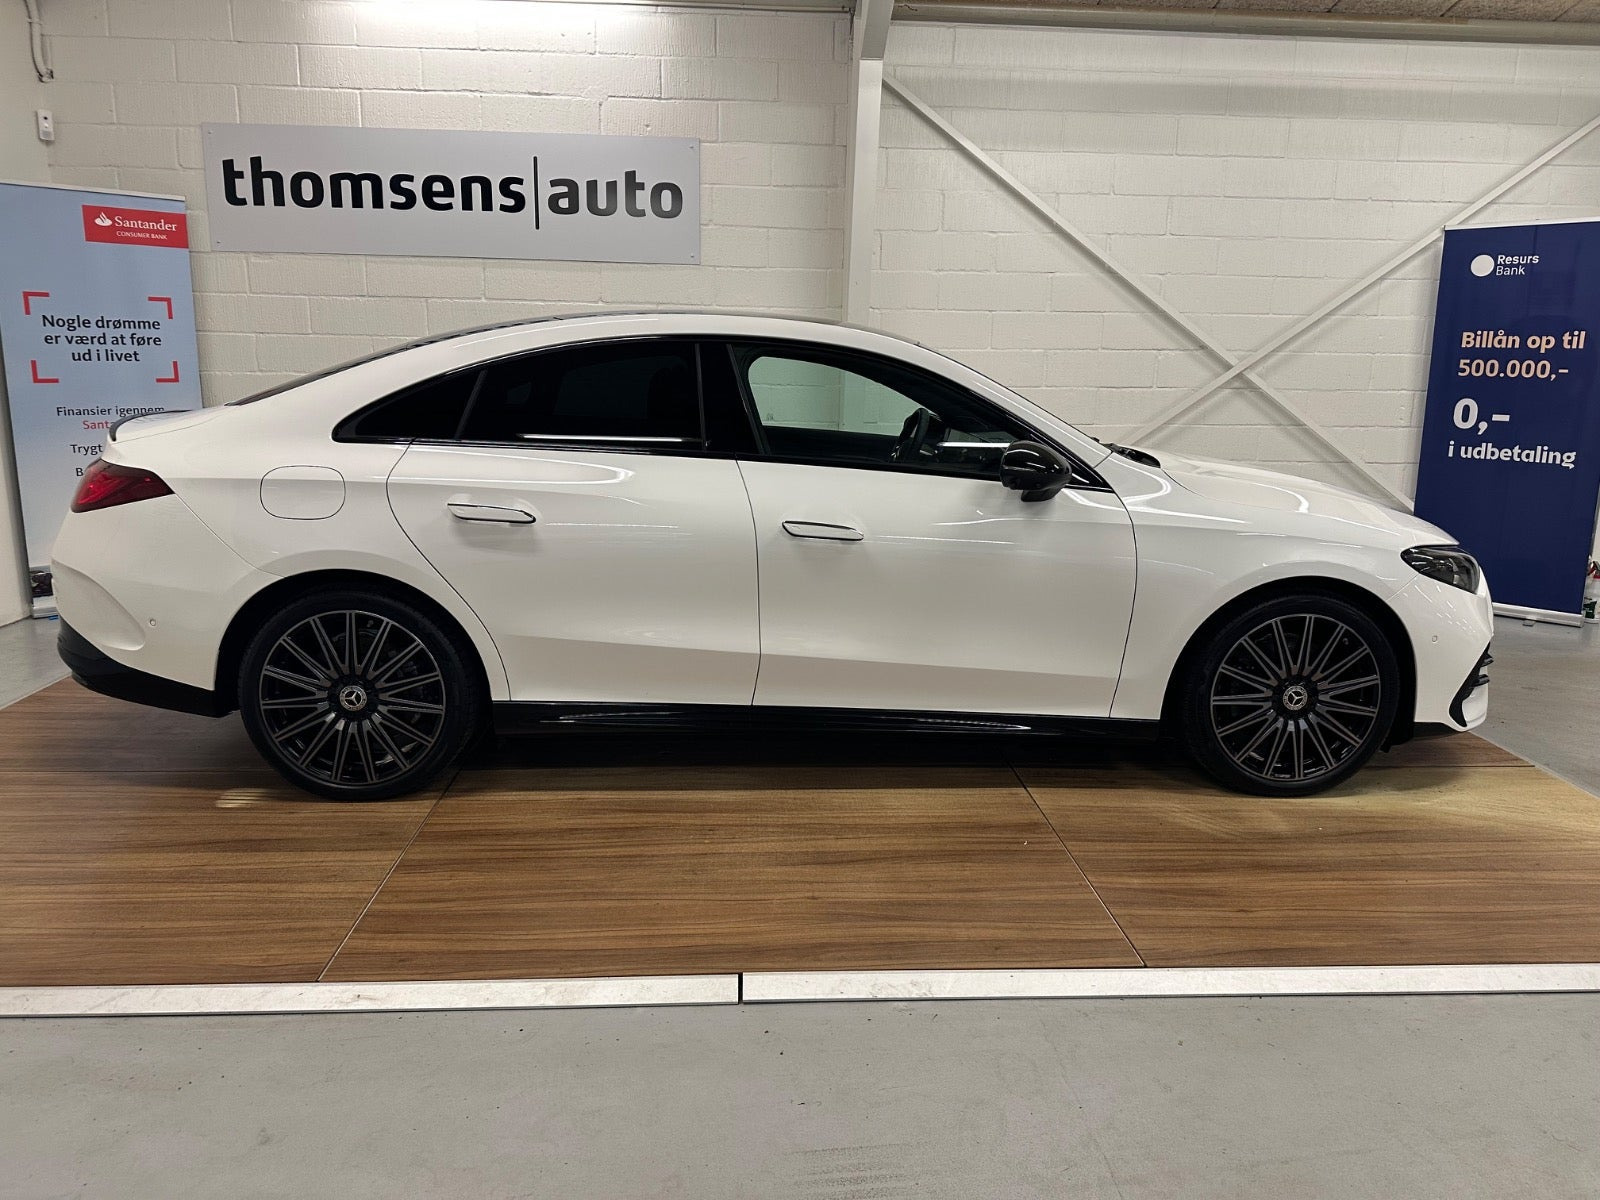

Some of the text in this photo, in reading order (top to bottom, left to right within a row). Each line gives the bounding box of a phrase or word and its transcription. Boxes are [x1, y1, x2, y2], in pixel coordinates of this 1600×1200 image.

[222, 156, 683, 219] thomsens auto
[115, 216, 177, 231] Santander
[1497, 254, 1540, 265] Resurs
[1496, 265, 1526, 276] Bank
[42, 314, 161, 332] Nogle drømme
[44, 333, 162, 347] er værd at føre
[1461, 329, 1586, 354] Billån op til
[71, 349, 141, 362] ud i livet
[56, 406, 112, 416] Finansier
[70, 444, 103, 455] Trygt
[1447, 440, 1577, 469] i udbetaling
